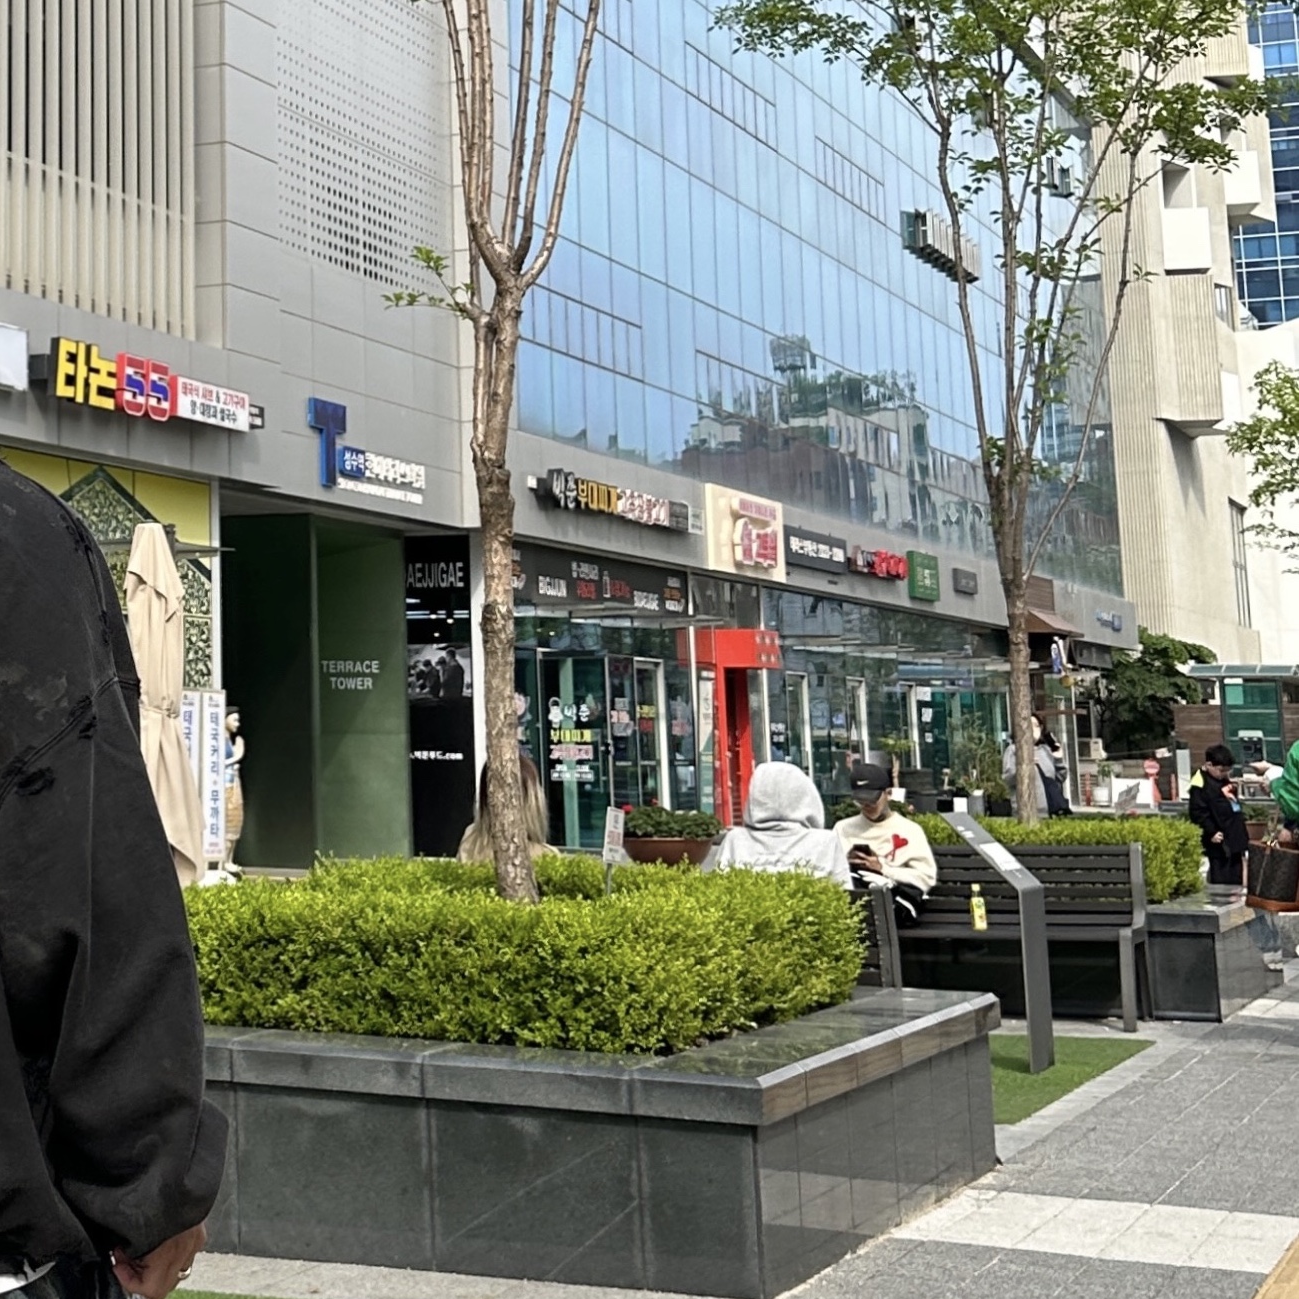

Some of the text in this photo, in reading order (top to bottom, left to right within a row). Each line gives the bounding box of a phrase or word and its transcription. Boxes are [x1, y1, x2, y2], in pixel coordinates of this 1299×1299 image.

[343, 449, 365, 473] 성수역
[406, 562, 464, 588] AEJJIGAE
[321, 660, 380, 674] TERRACE
[330, 677, 373, 690] TOWER
